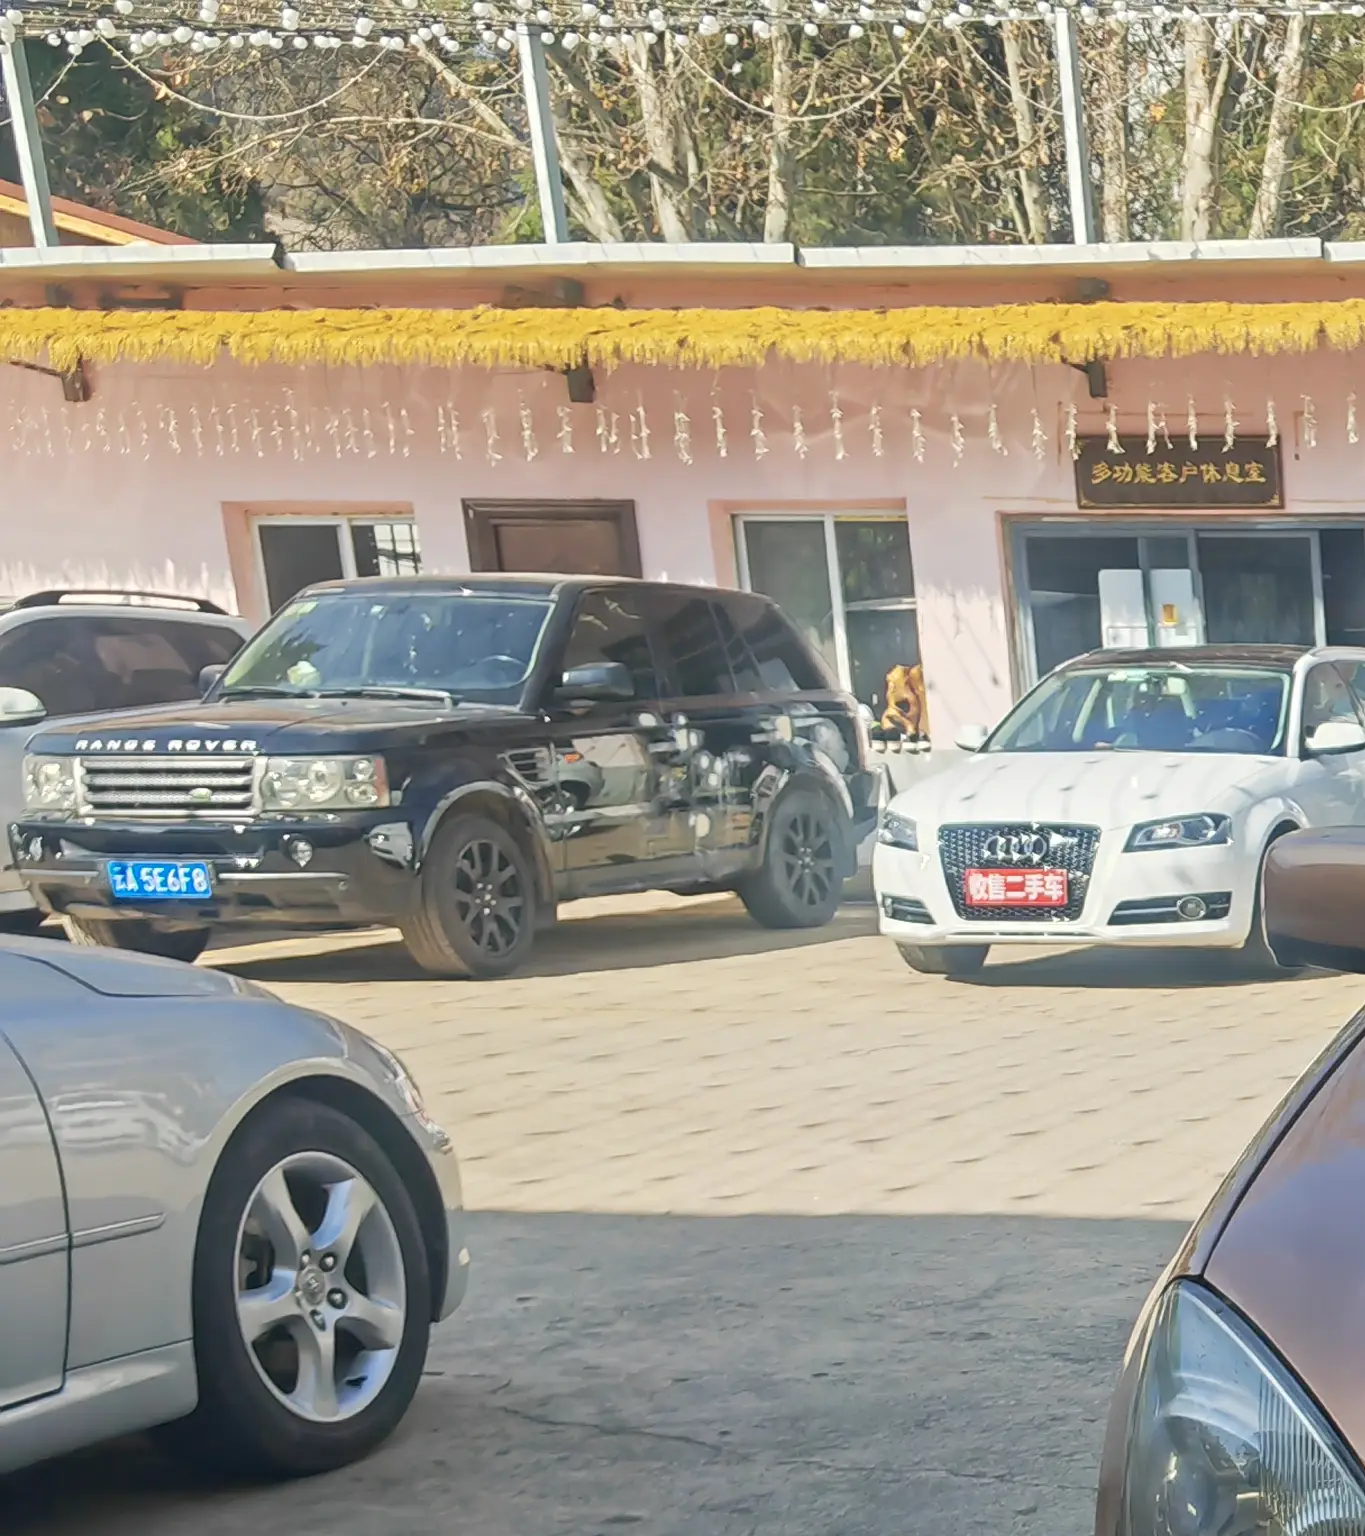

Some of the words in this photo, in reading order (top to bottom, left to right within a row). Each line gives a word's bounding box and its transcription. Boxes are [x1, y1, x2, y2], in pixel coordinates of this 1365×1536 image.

[1091, 461, 1266, 484] 多功能客户休息室
[75, 739, 156, 750] RANGE
[168, 739, 257, 751] ROVER
[968, 873, 1064, 900] 收售二手车
